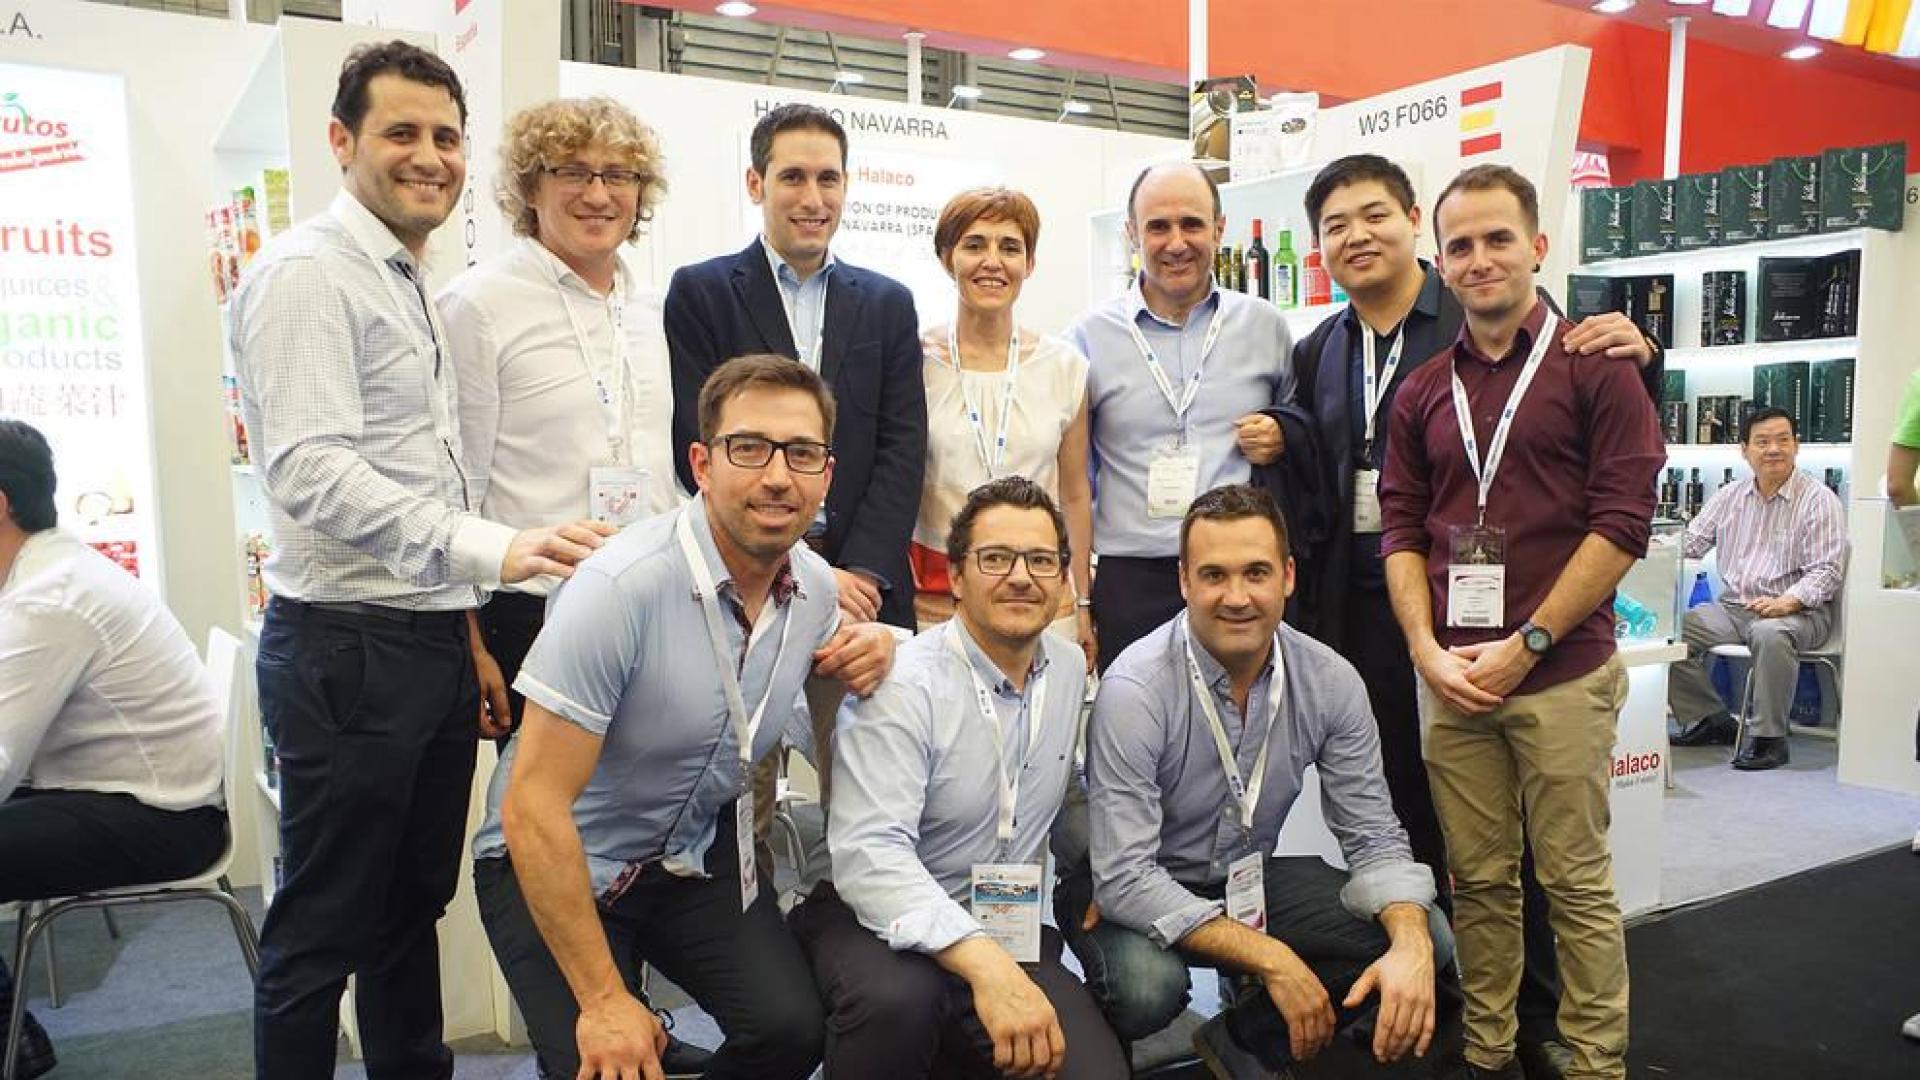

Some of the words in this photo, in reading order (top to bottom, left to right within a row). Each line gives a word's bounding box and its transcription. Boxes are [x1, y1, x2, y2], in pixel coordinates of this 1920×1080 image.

[850, 111, 949, 139] NAVARRA
[1358, 110, 1389, 137] W3
[1396, 95, 1448, 128] F066
[858, 166, 914, 186] Halaco
